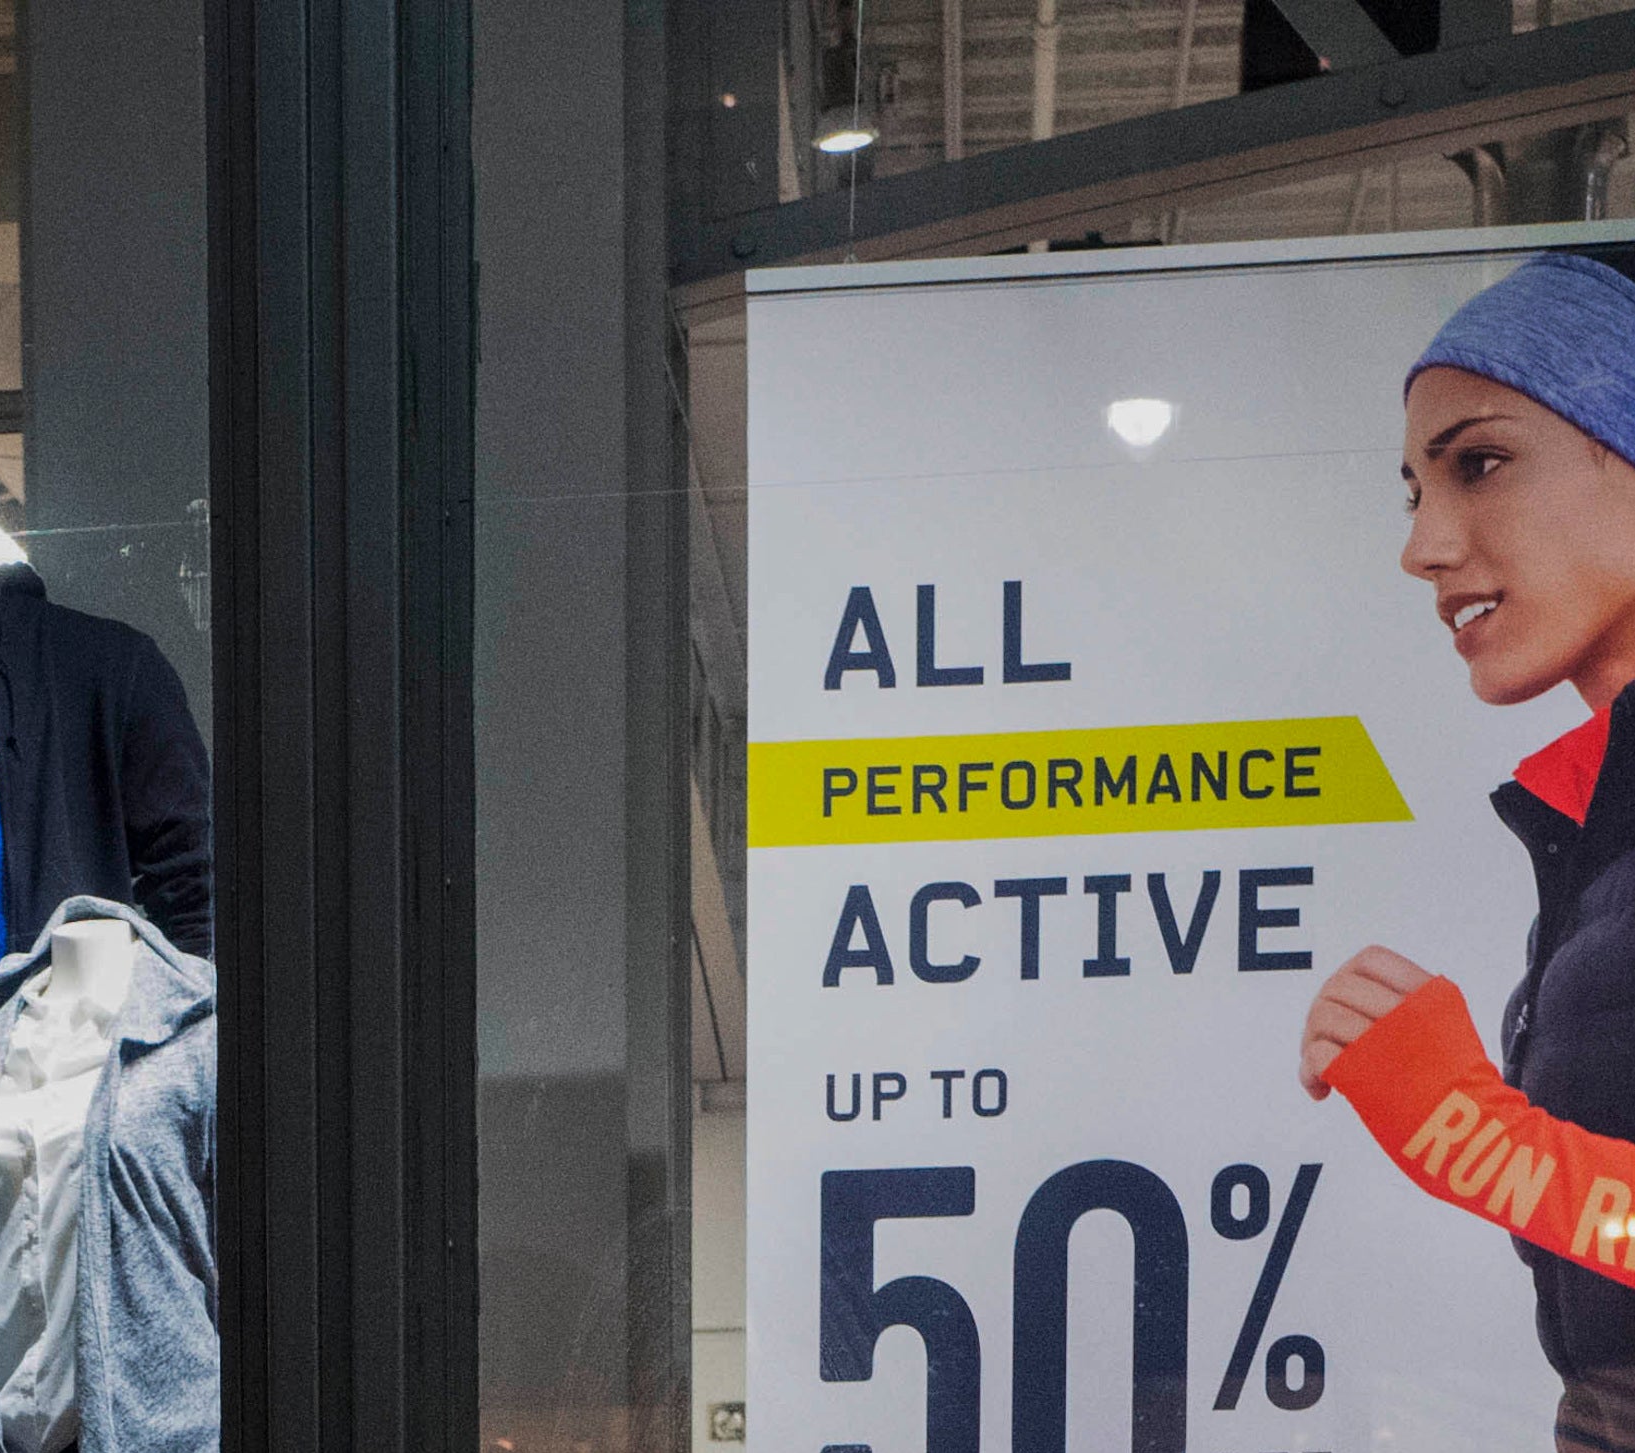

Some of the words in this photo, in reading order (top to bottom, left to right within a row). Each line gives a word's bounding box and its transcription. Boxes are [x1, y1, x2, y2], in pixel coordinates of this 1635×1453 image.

[825, 581, 1070, 689] ALL
[824, 747, 1321, 816] PERFORMANCE
[824, 867, 1313, 986] ACTIVE
[827, 1073, 906, 1121] UP
[931, 1069, 1006, 1117] TO
[1403, 1091, 1558, 1228] RUN
